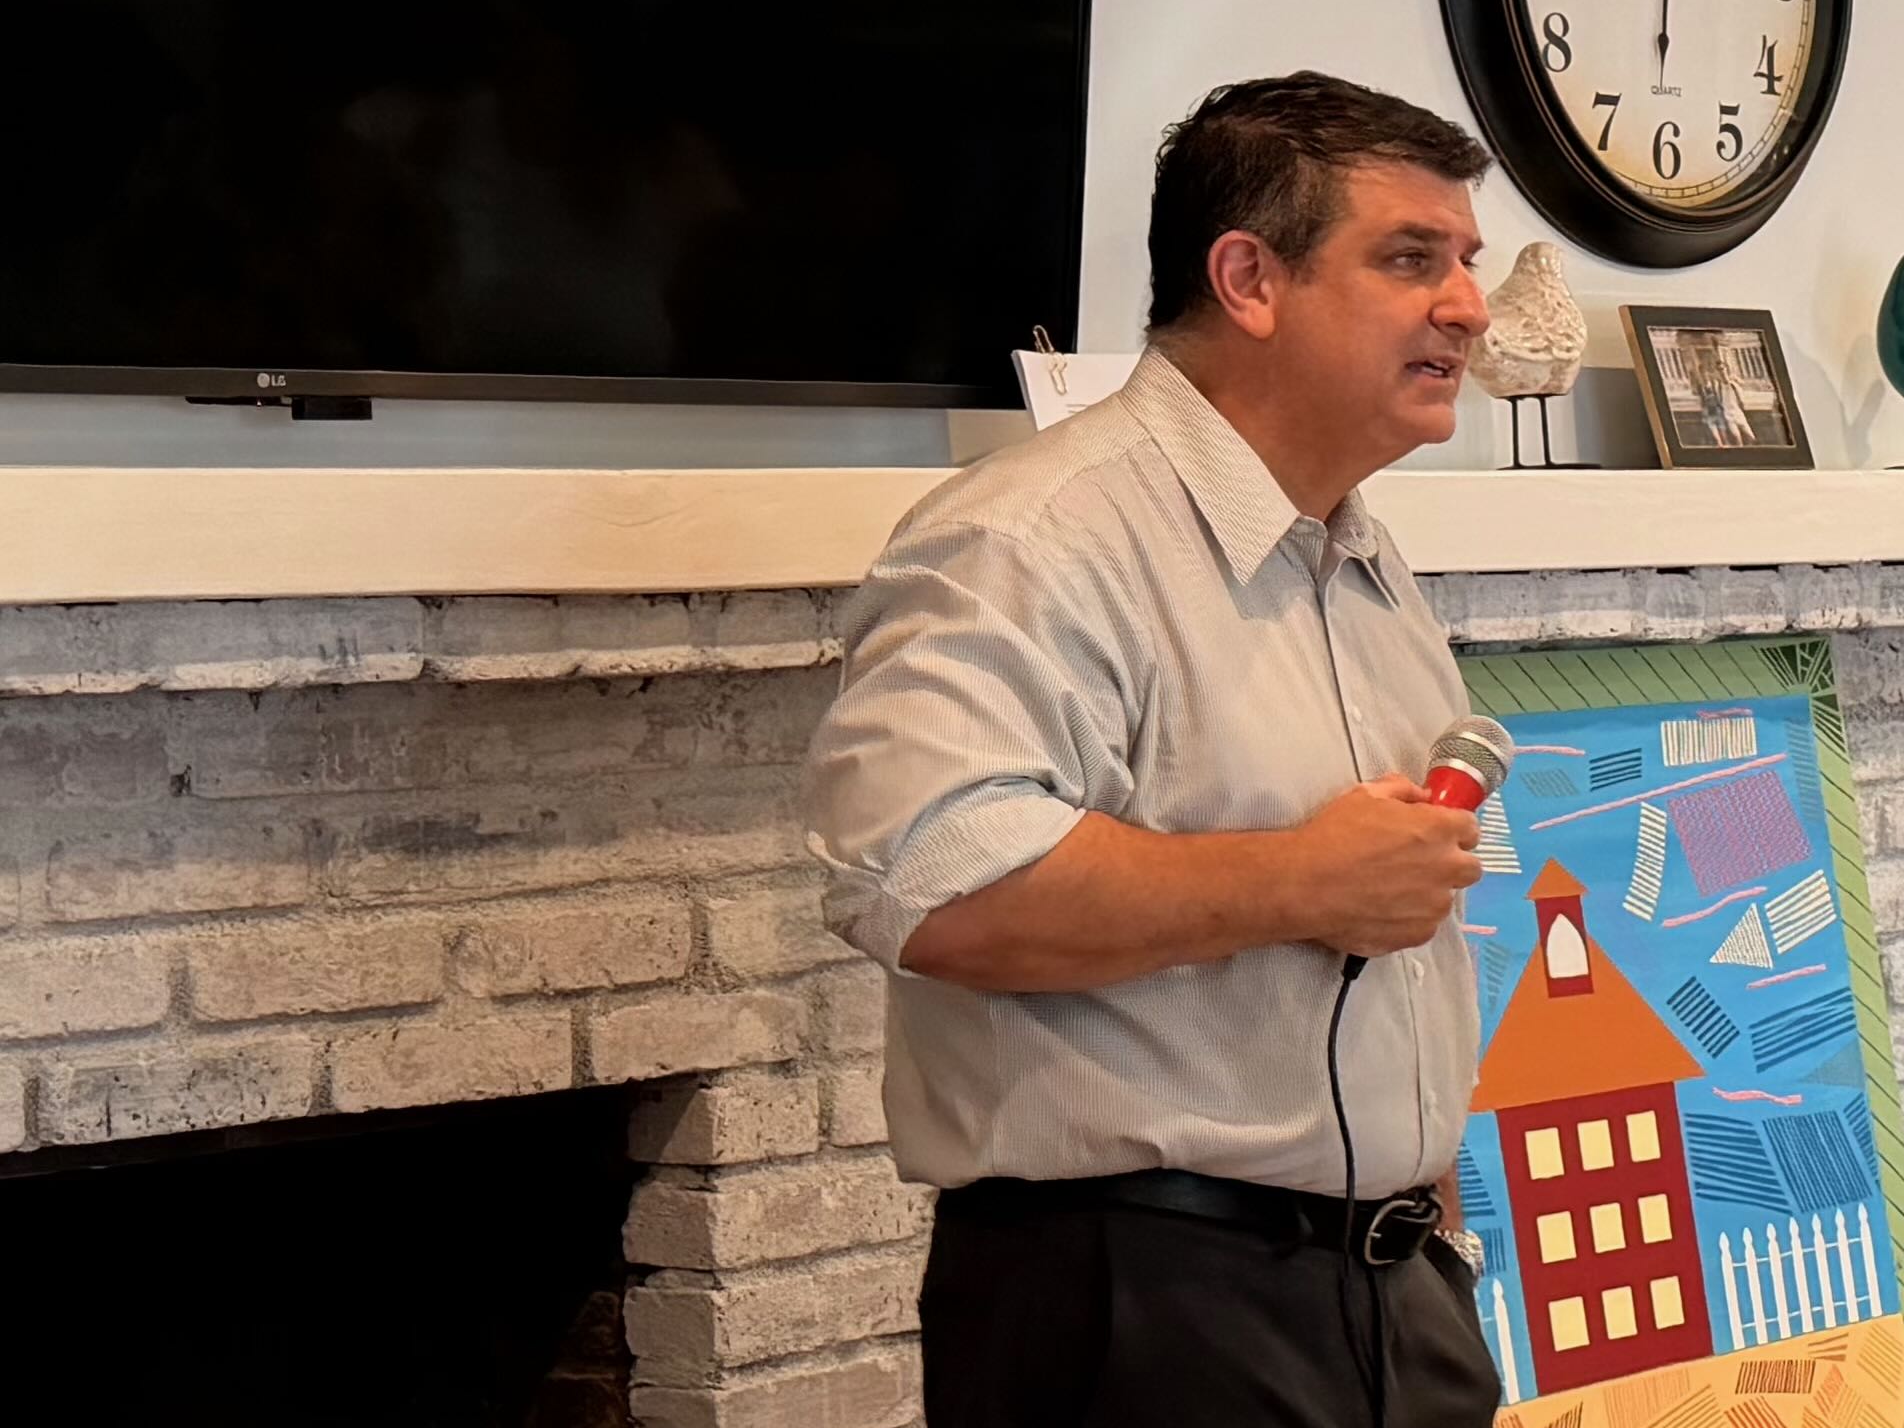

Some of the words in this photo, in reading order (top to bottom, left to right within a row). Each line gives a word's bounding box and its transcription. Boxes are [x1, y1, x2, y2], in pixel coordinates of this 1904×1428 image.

[1541, 12, 1572, 73] 8
[1753, 35, 1784, 97] 4
[1592, 92, 1621, 152] 7
[1652, 121, 1681, 180] 6
[1716, 103, 1743, 161] 5
[270, 374, 287, 387] LG
